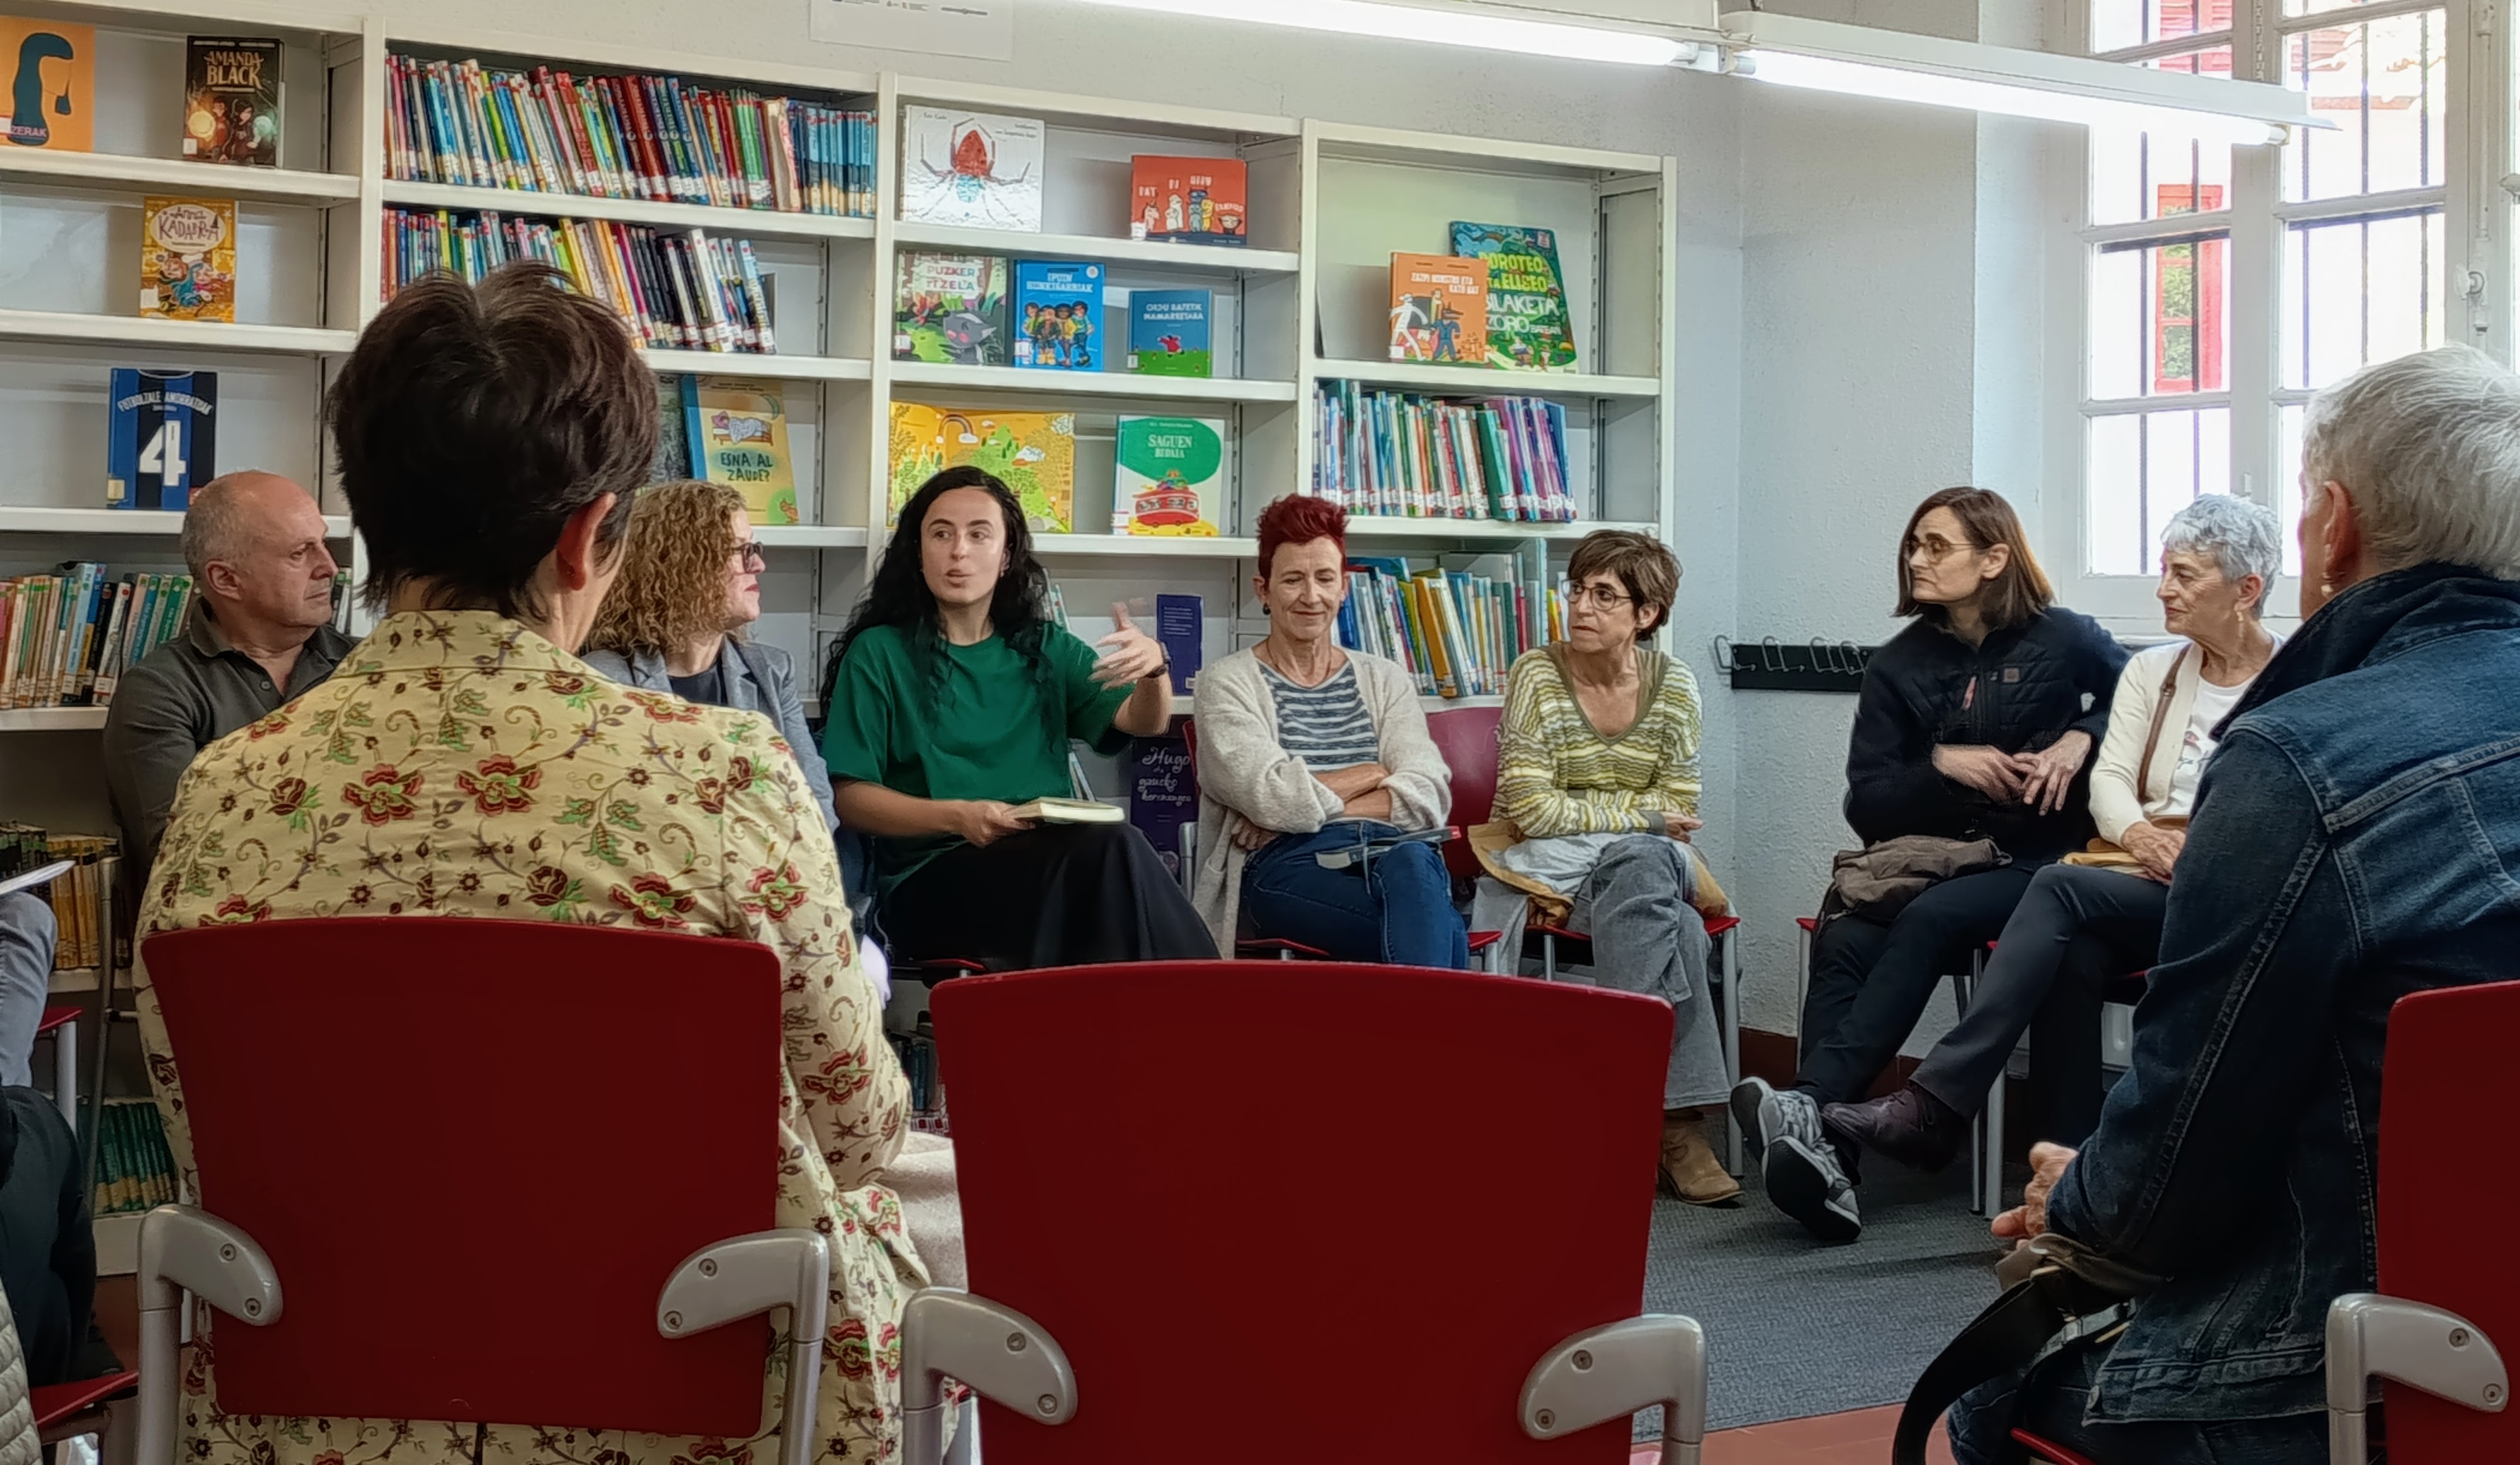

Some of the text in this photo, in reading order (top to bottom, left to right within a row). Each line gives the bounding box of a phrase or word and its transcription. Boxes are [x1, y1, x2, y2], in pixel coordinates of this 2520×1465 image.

[203, 50, 265, 66] AMANDA
[206, 63, 264, 90] BLACK
[927, 265, 975, 277] PUZKER
[1501, 273, 1548, 292] ELISEO
[1148, 434, 1193, 448] SAGUEN
[139, 420, 186, 486] 4
[721, 452, 774, 468] ESNA AL
[727, 468, 770, 482] ZAUDE?
[1142, 746, 1190, 774] Hugo
